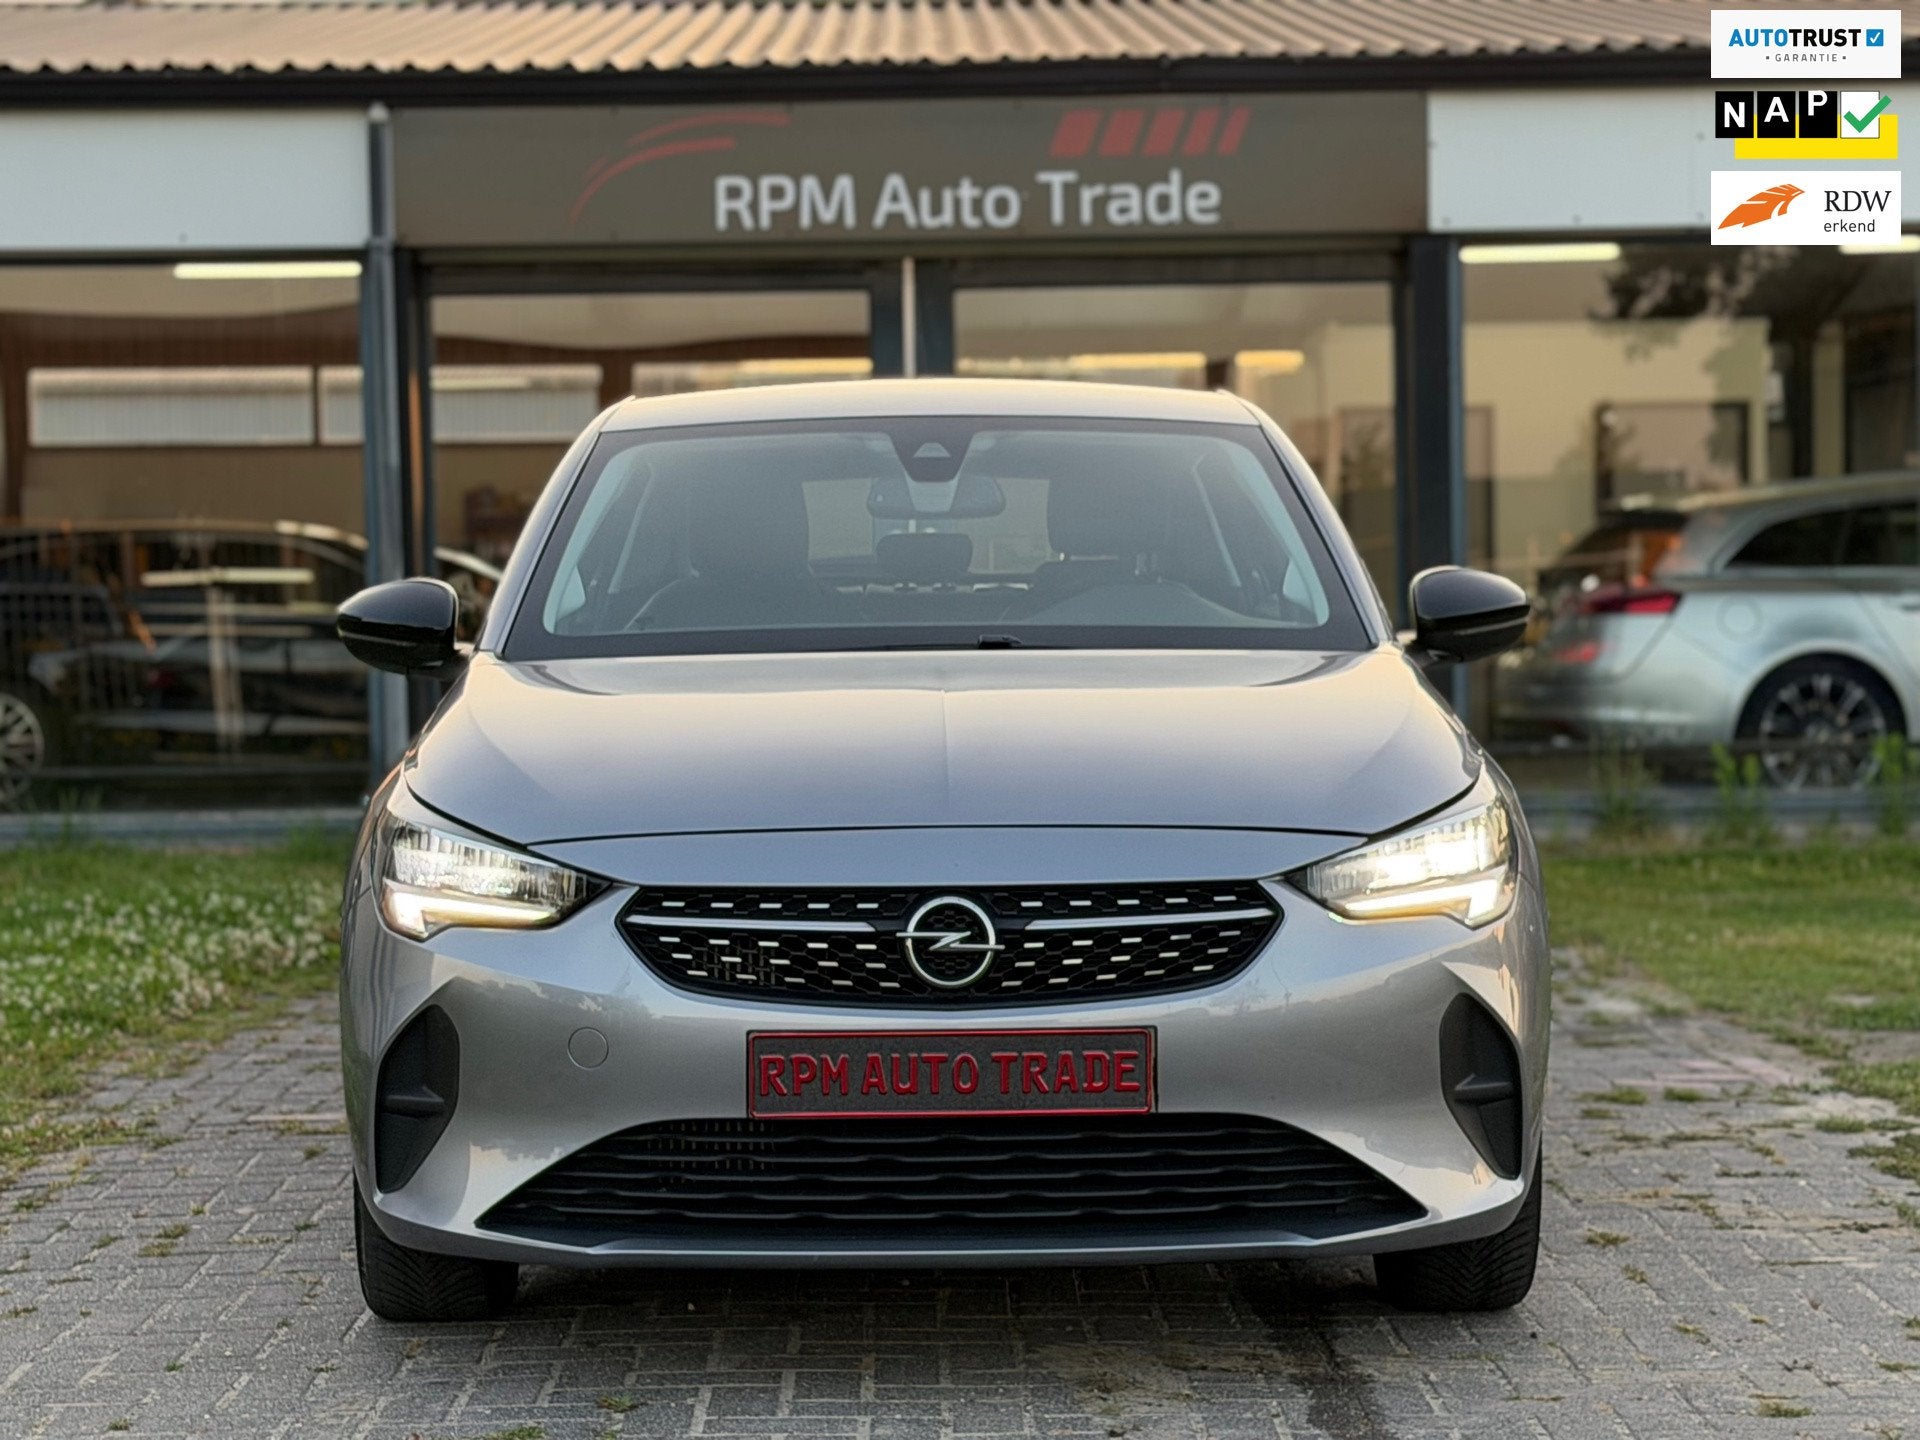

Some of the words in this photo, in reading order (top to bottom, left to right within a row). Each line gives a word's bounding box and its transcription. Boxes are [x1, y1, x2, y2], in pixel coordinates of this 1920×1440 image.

[714, 174, 857, 231] RPM
[872, 172, 1021, 229] Auto
[1036, 168, 1221, 226] Trade
[759, 1053, 849, 1096] RPM
[861, 1052, 980, 1095] AUTO
[991, 1050, 1141, 1093] TRADE
